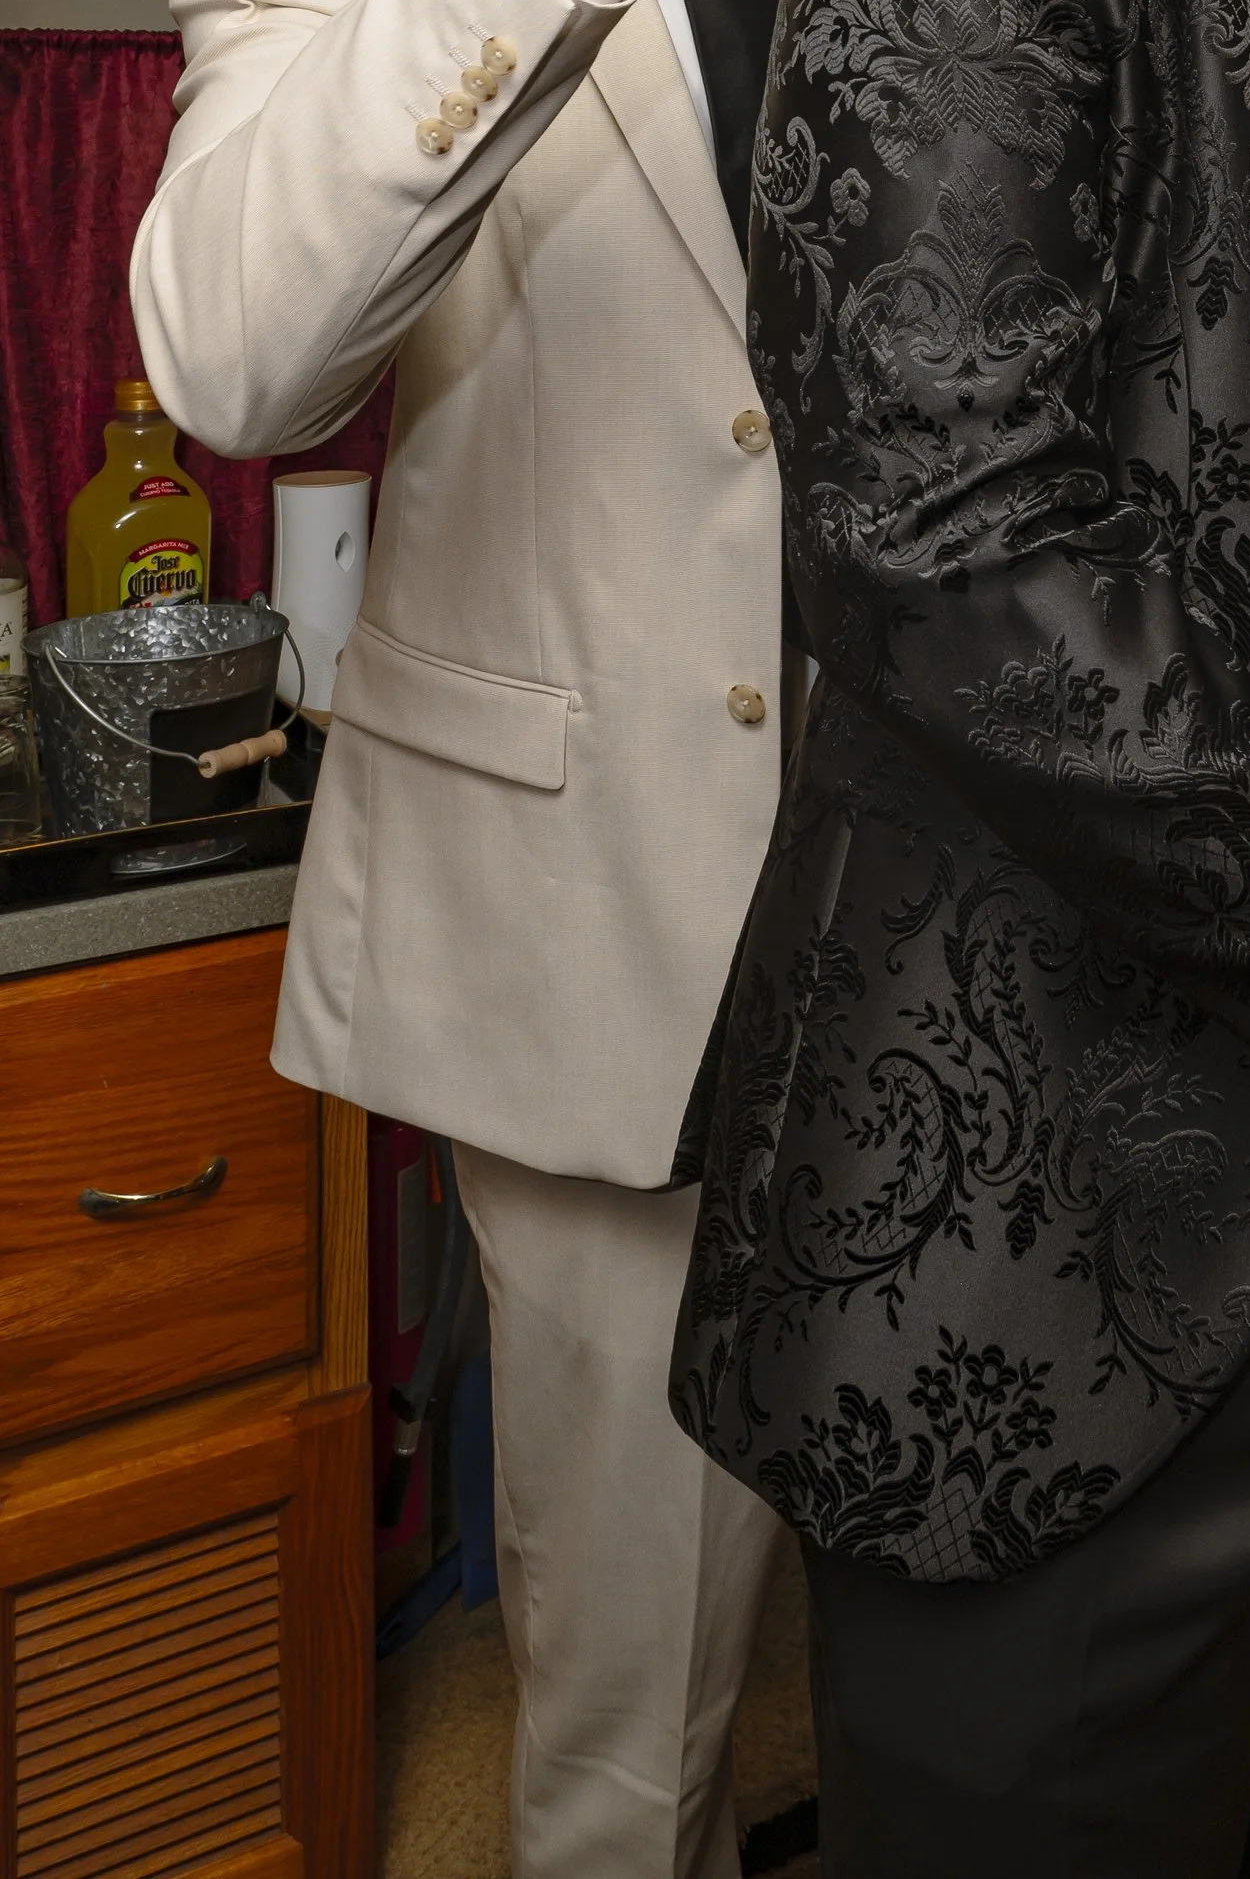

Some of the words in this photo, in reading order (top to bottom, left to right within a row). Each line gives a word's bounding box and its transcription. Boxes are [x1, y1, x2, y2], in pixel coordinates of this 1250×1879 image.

[144, 482, 159, 490] JUST
[139, 542, 177, 555] MARGARITA
[177, 542, 190, 550] MIX
[151, 556, 179, 571] Jose
[127, 567, 197, 599] Cuervo
